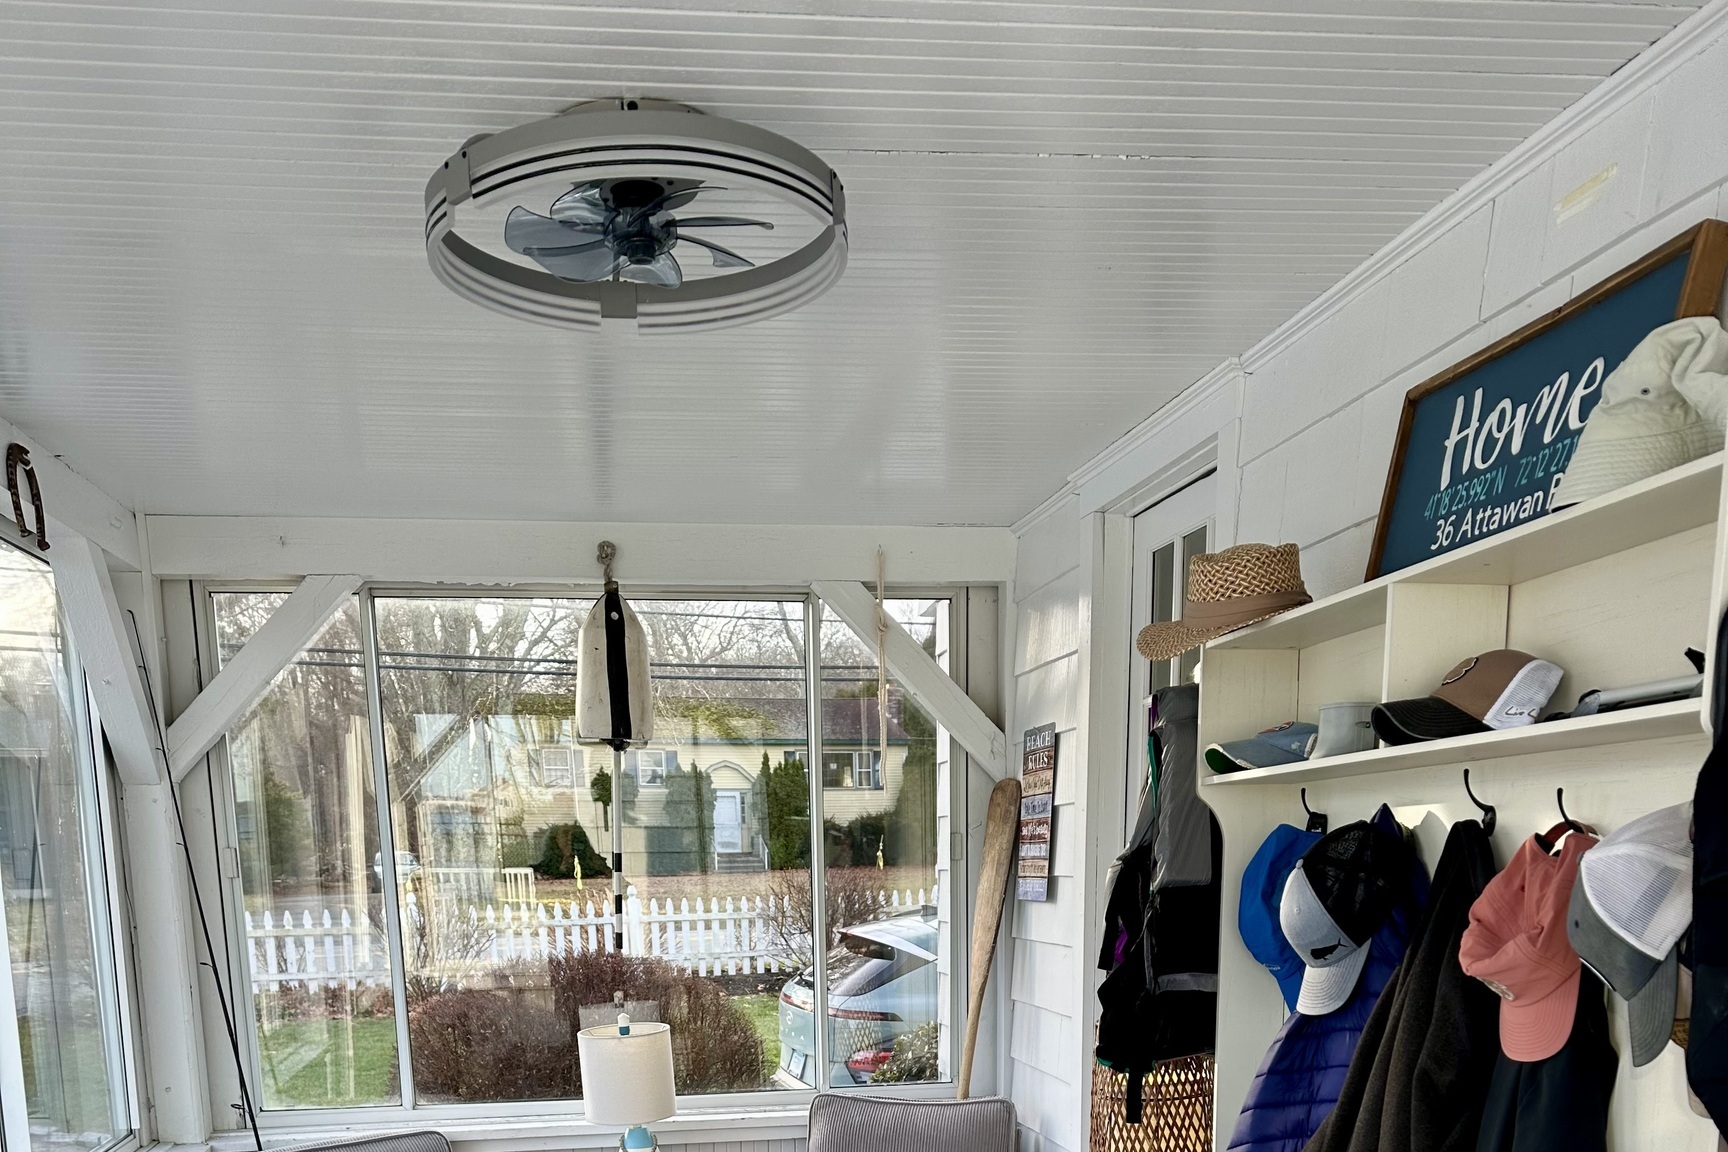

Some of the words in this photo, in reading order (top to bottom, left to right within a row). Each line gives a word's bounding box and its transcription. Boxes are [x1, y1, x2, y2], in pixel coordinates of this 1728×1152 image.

[1440, 356, 1605, 492] Home
[1430, 514, 1457, 550] 36
[1456, 490, 1544, 543] Attawan
[1026, 730, 1052, 752] BEACH
[1027, 751, 1049, 770] RULES
